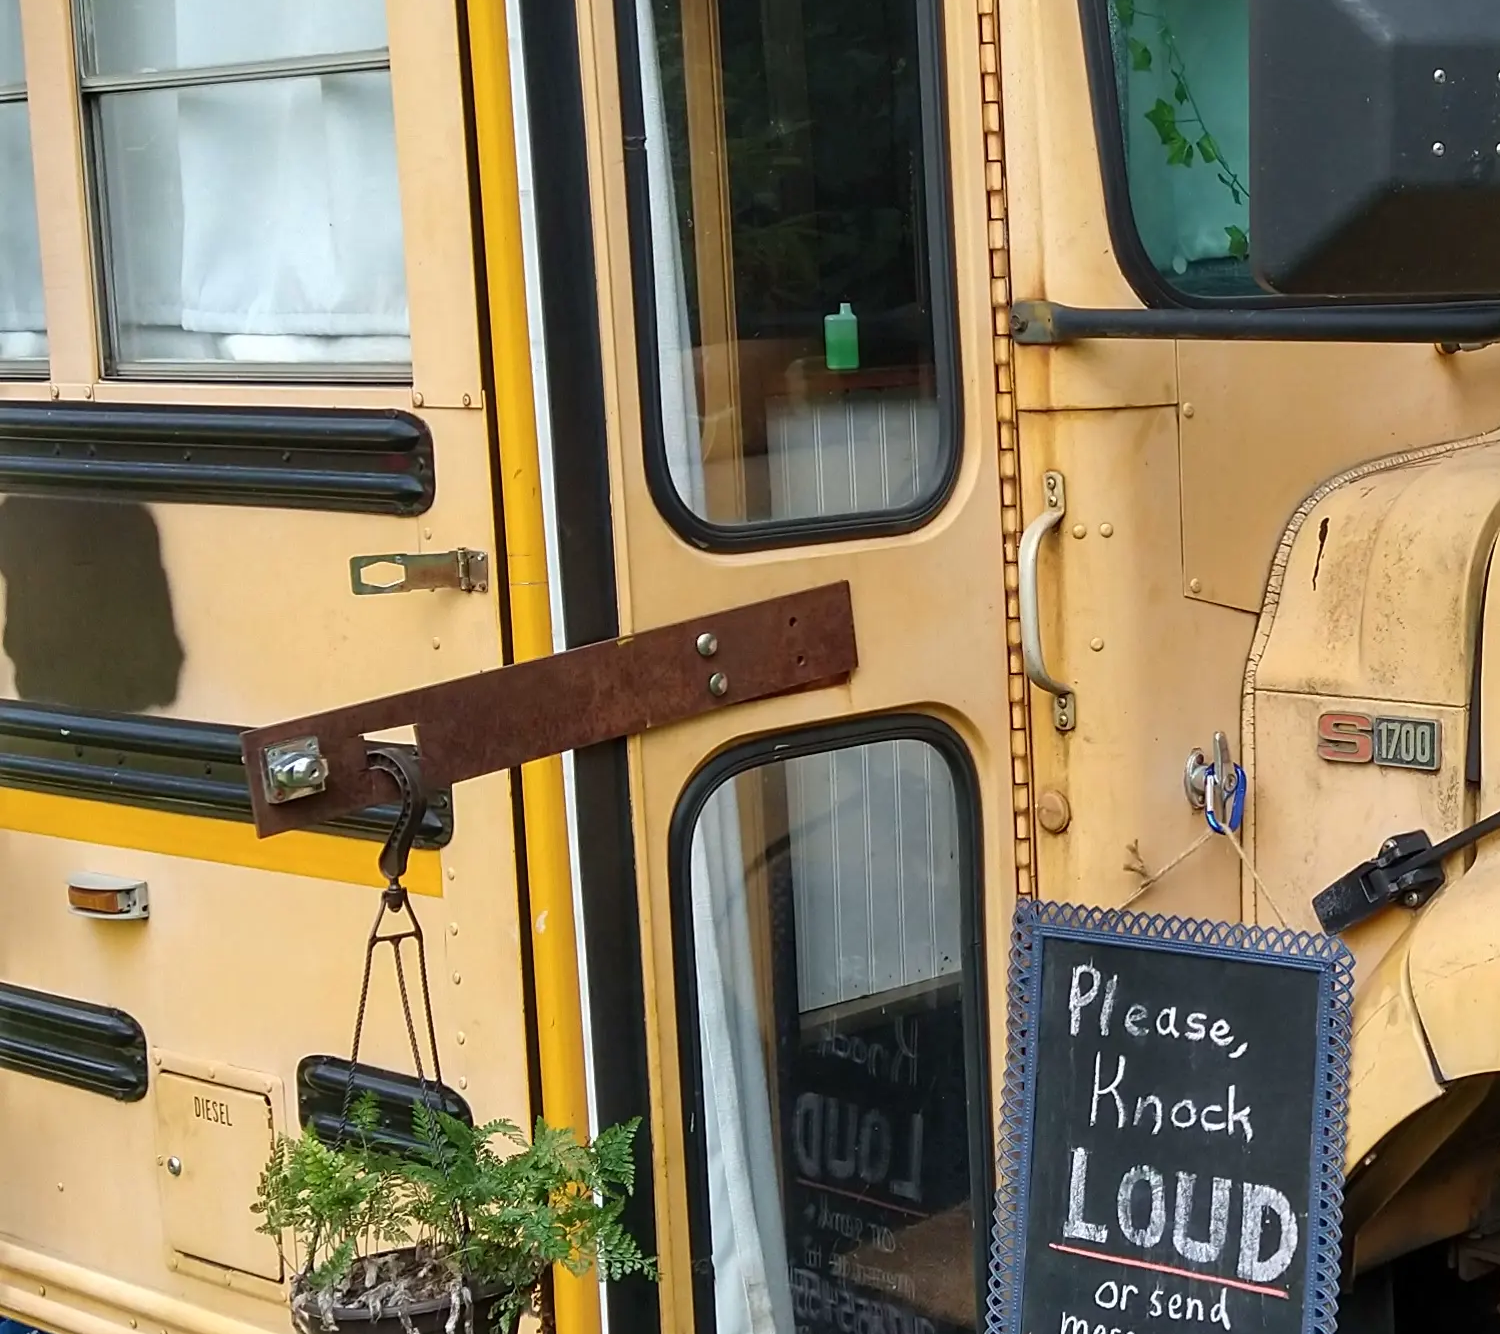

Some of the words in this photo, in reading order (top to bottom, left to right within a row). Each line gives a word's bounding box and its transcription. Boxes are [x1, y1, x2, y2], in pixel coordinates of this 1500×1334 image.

[1068, 958, 1248, 1058] Please,
[193, 1095, 233, 1127] DIESEL
[1089, 1053, 1254, 1142] Knock
[1063, 1147, 1299, 1283] LOUD
[1095, 1280, 1137, 1312] or
[1150, 1289, 1231, 1330] send
